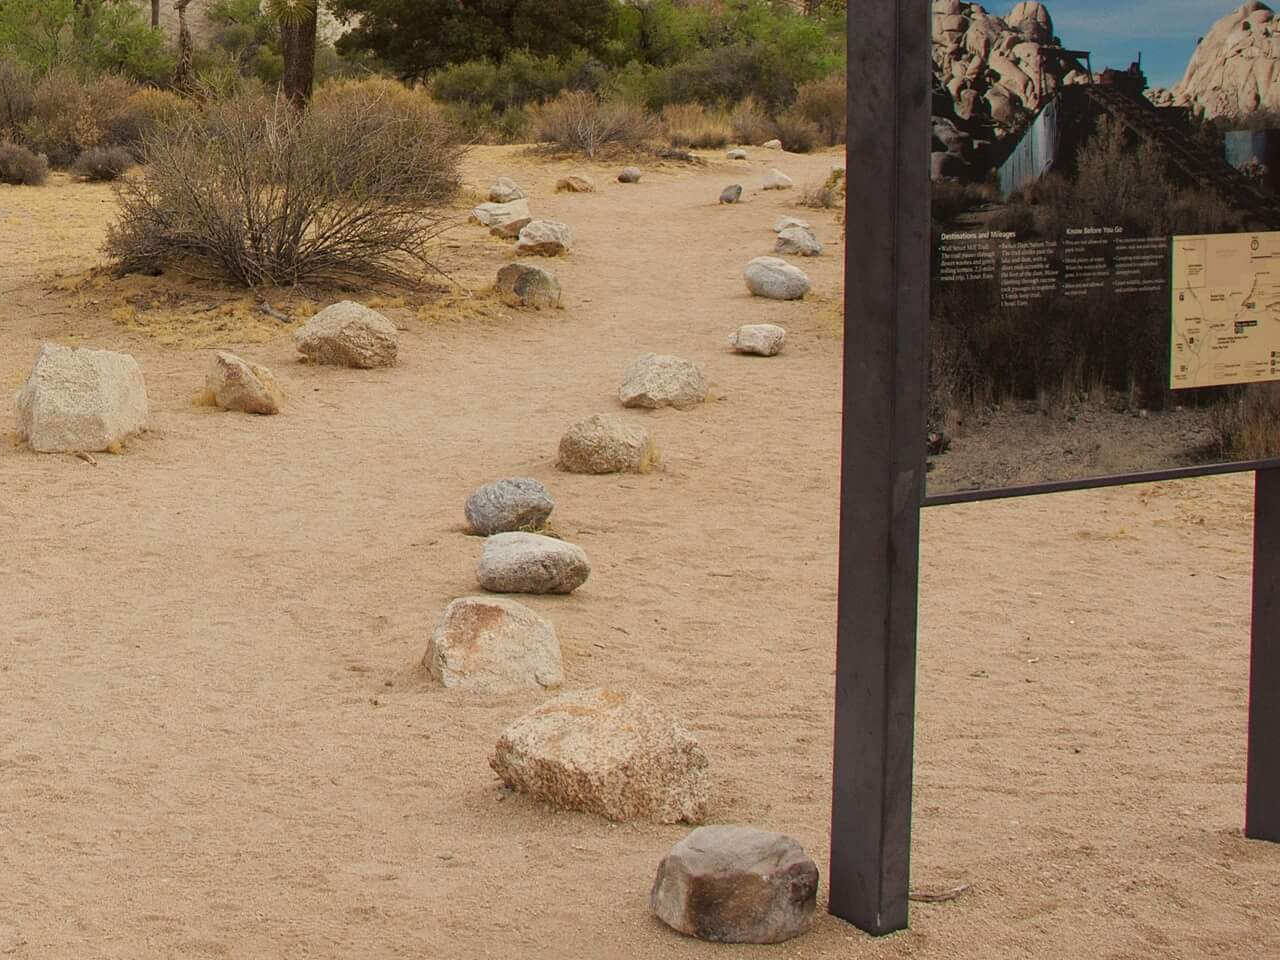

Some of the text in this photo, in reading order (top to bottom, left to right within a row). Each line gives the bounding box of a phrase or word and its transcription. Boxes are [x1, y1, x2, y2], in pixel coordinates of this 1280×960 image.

[1084, 226, 1102, 234] Before
[1114, 225, 1123, 233] Go
[941, 231, 1016, 240] Destinations and Mileages
